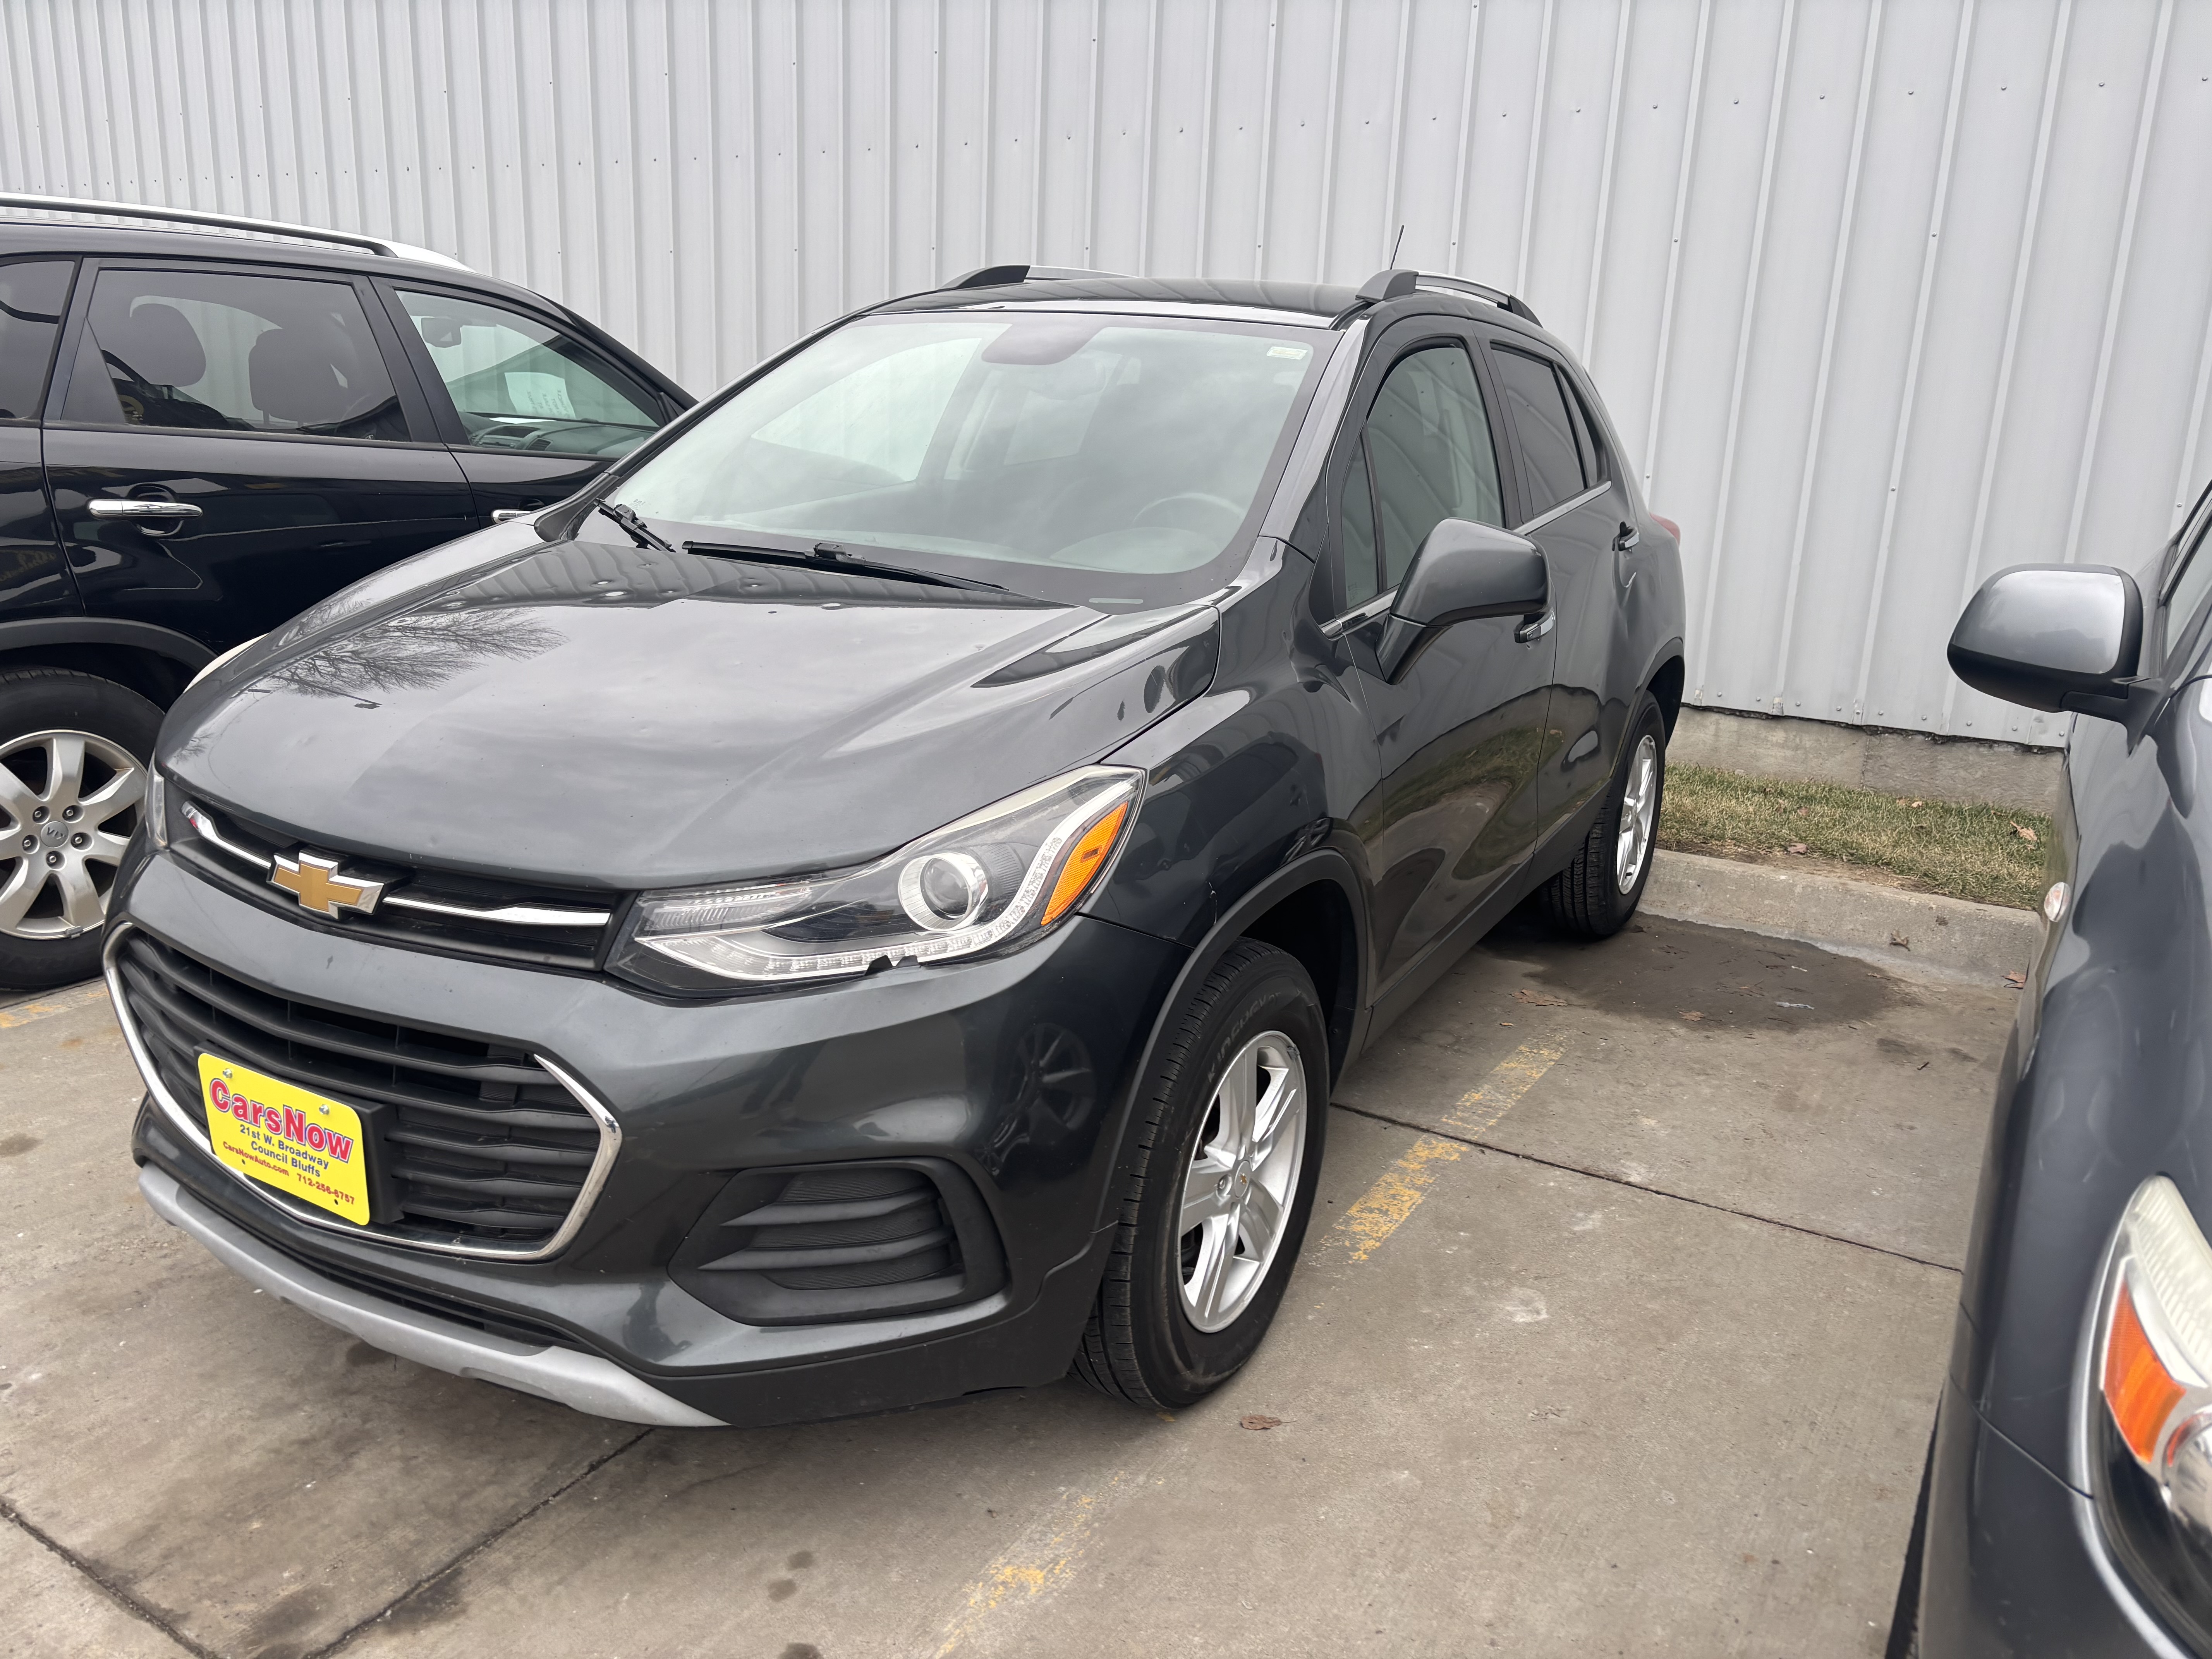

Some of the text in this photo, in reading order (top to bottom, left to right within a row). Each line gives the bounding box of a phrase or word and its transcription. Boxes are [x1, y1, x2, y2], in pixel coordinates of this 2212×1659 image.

[210, 1078, 354, 1164] CarsNow
[223, 1141, 289, 1176] CarsNowAuto.com
[240, 1124, 329, 1170] 21st W. Broadway
[251, 1141, 320, 1177] Council Bluffs
